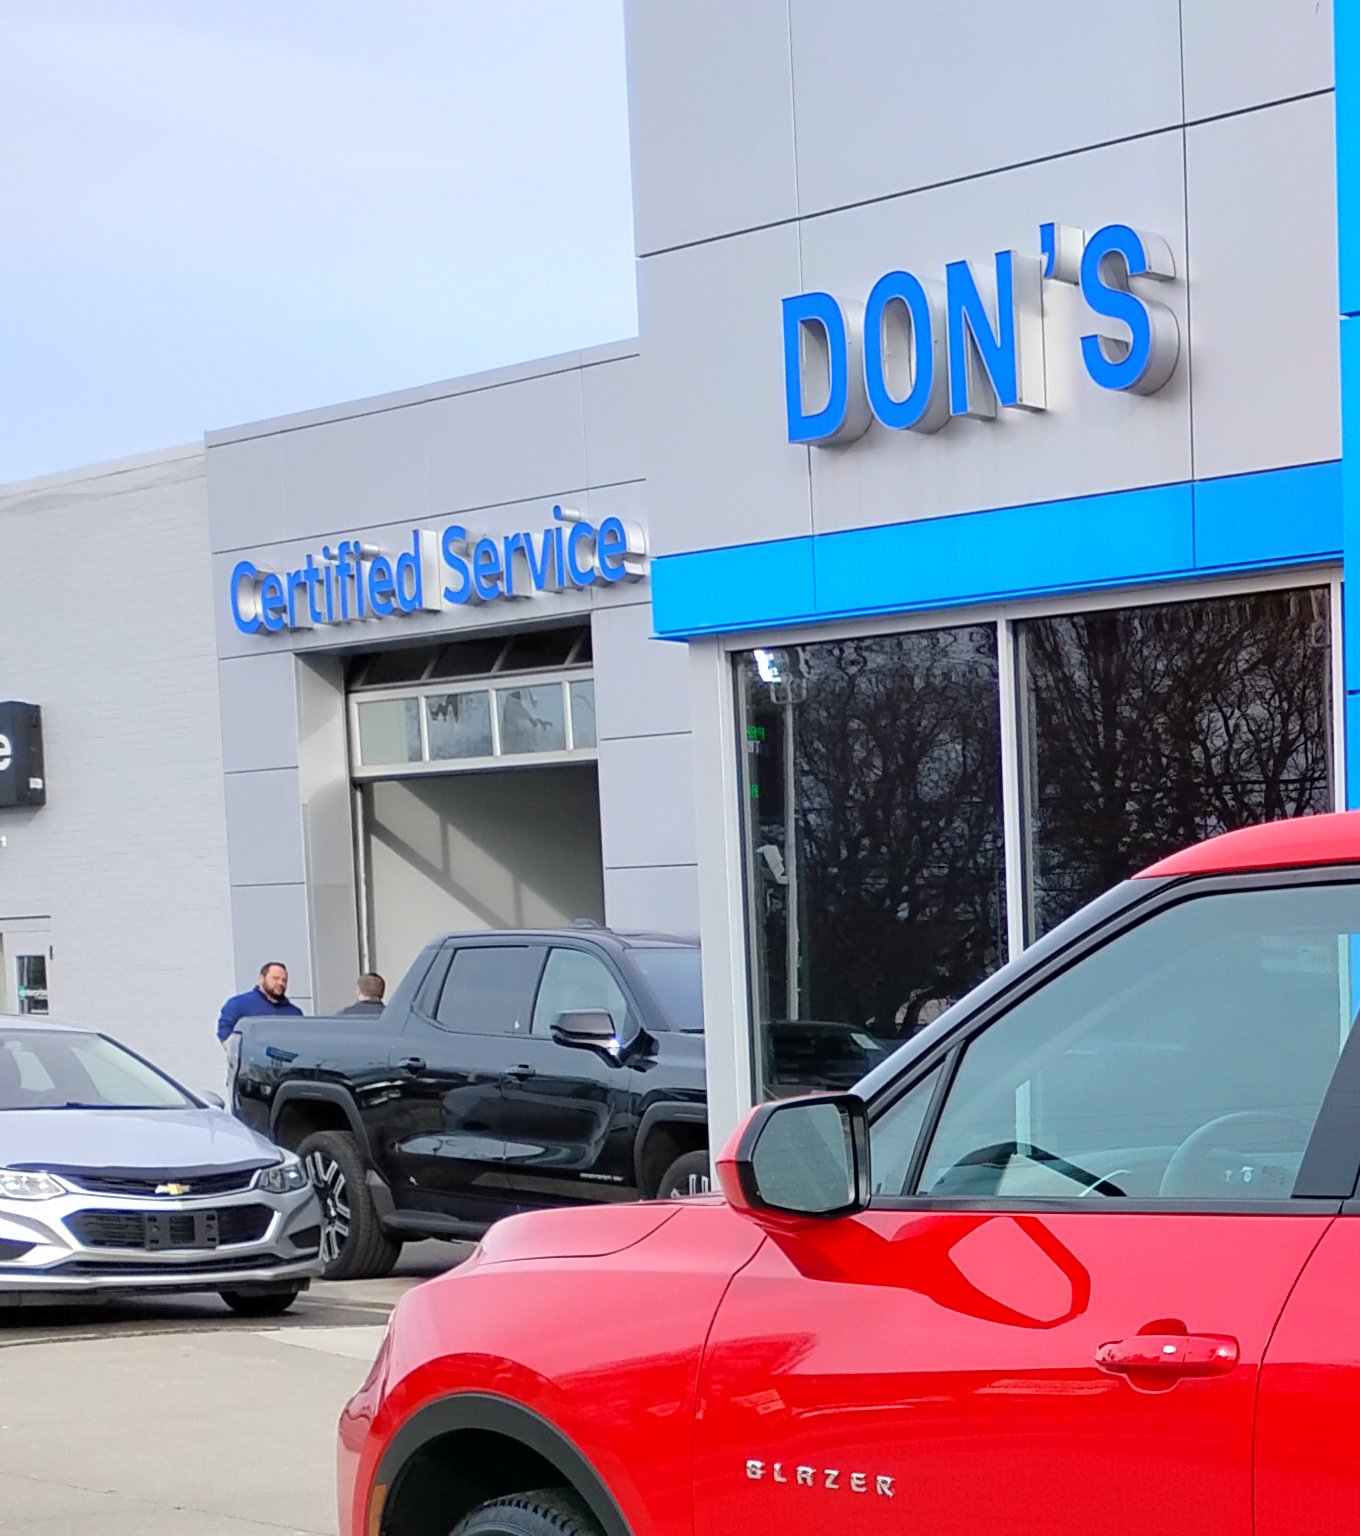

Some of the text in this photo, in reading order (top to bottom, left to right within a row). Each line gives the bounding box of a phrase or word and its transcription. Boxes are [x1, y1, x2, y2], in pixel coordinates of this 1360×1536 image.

[781, 222, 1170, 445] DON'S
[230, 504, 640, 635] Certified Service
[745, 1459, 896, 1499] BLAZER
